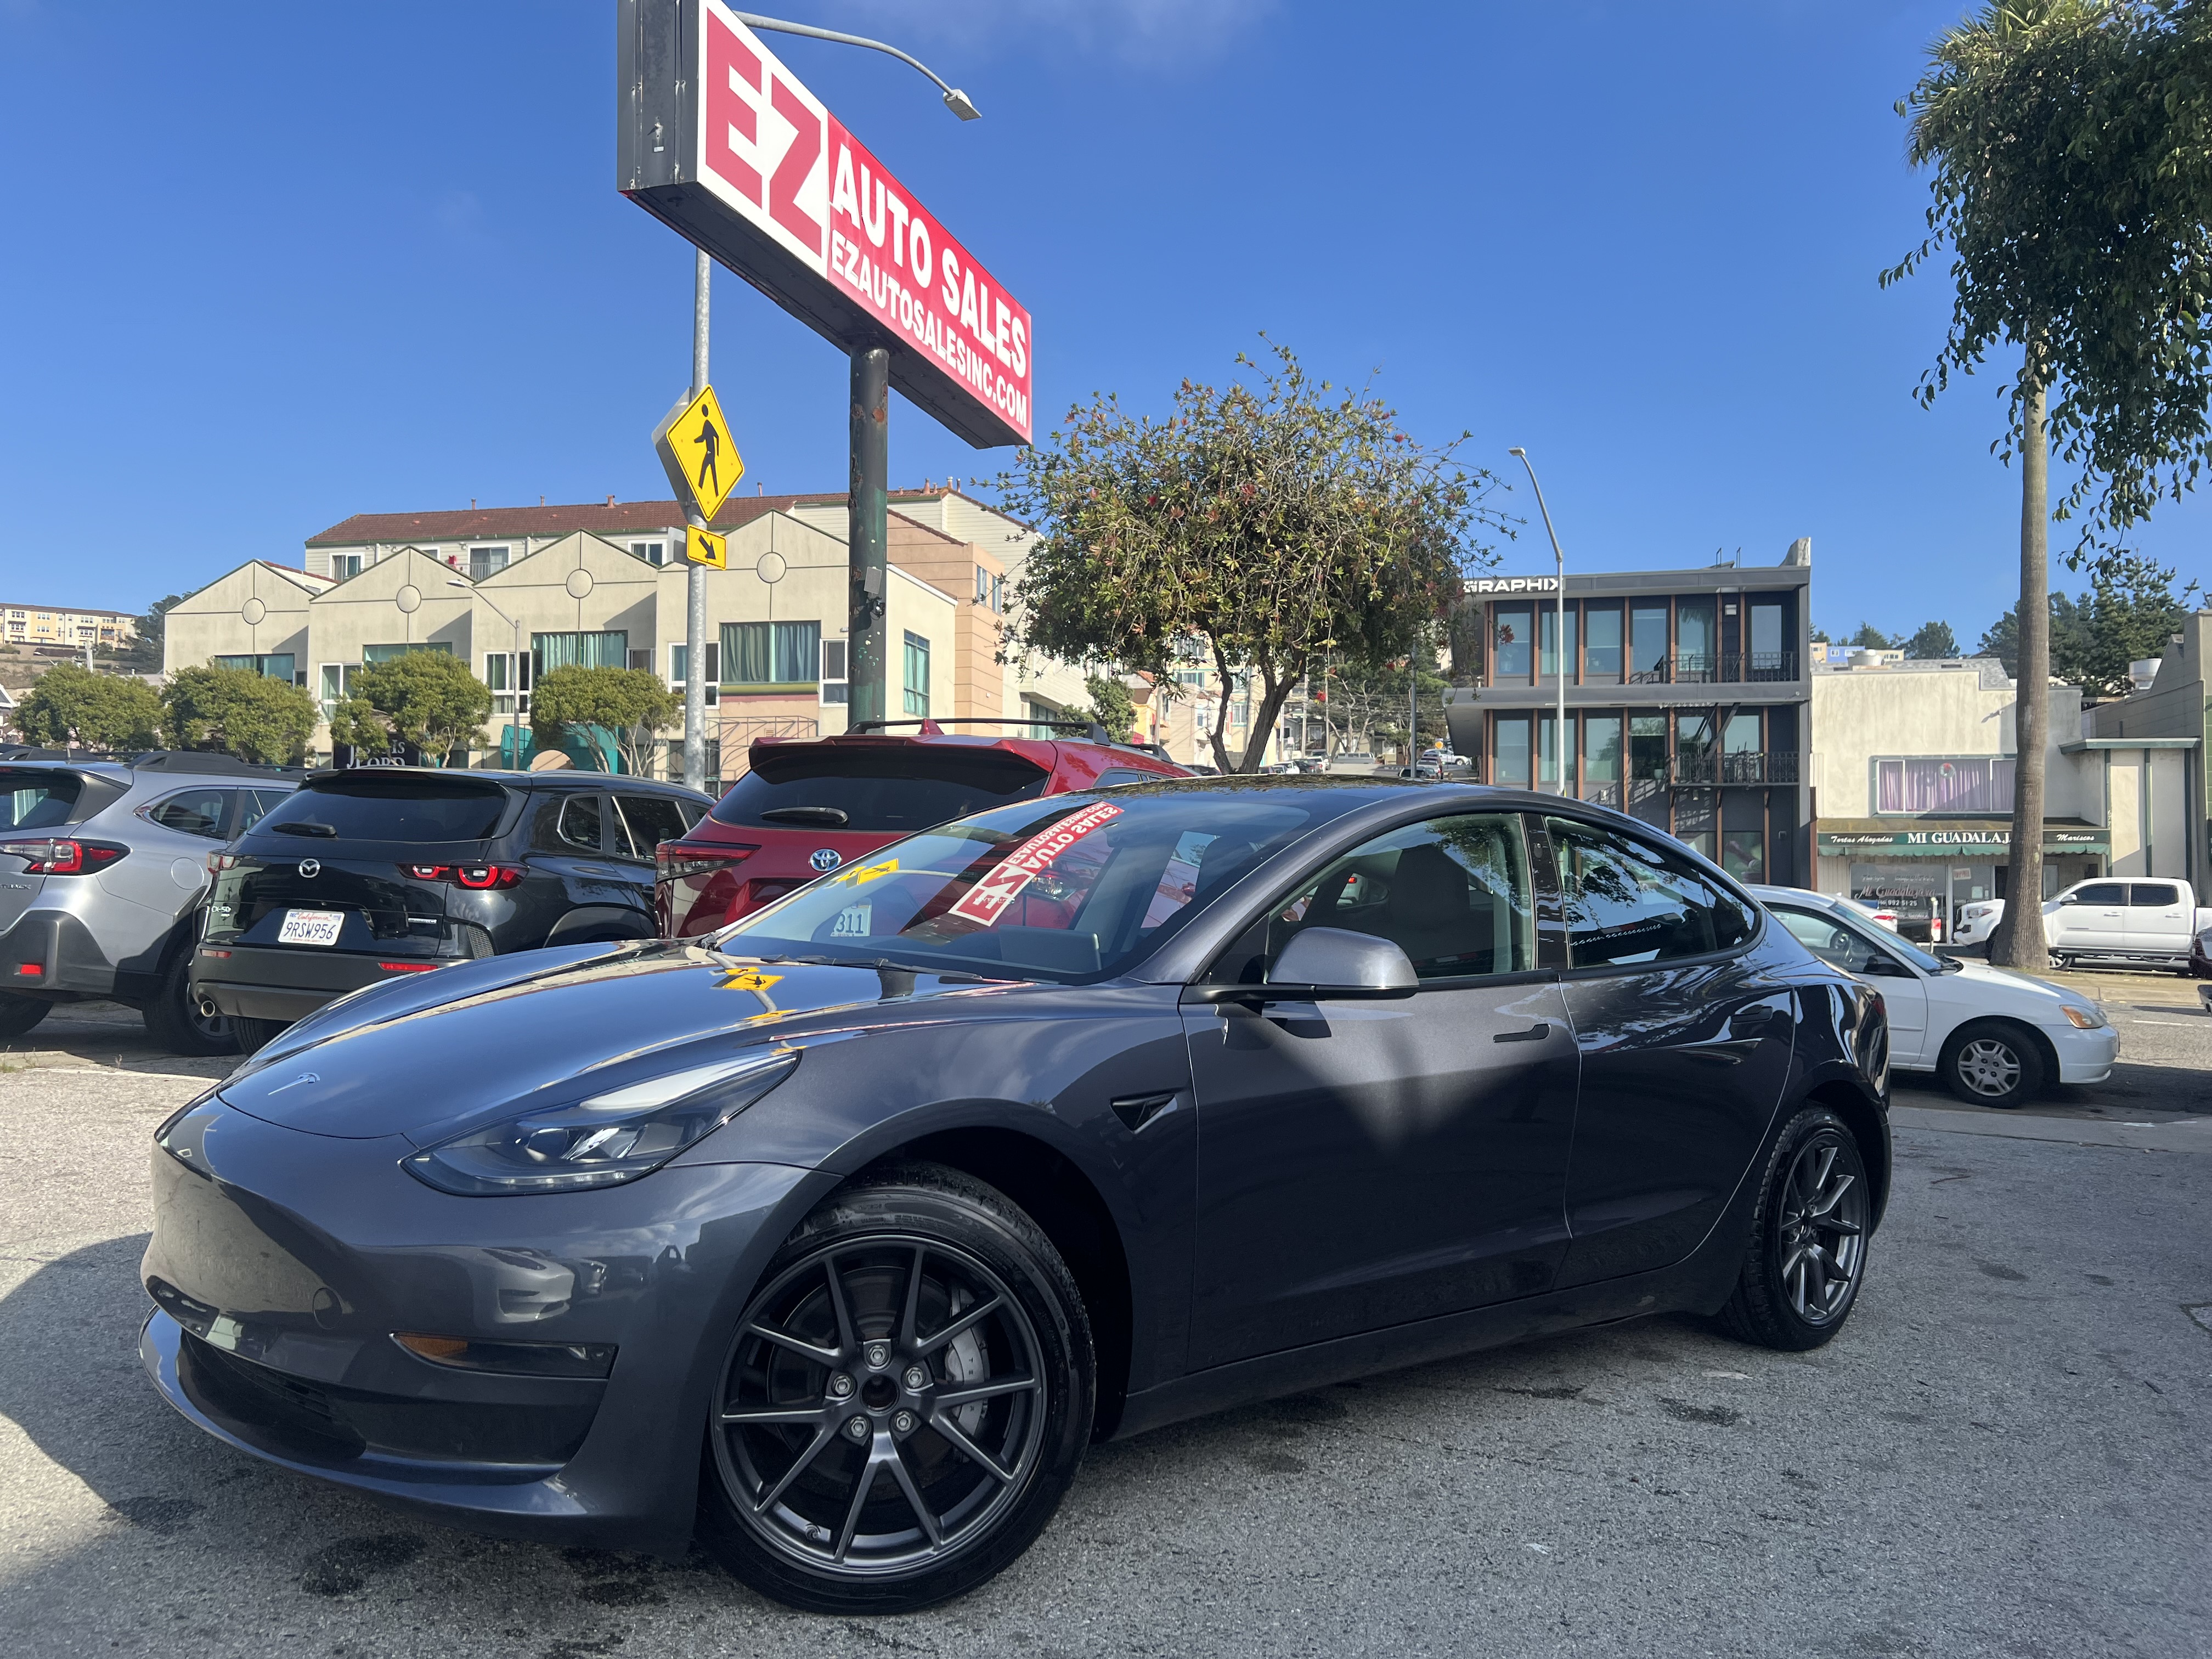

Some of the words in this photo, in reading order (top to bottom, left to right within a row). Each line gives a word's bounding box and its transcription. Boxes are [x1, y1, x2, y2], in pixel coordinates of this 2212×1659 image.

[706, 7, 822, 258] EZ
[830, 143, 932, 288] AUTO
[942, 248, 1026, 378] SALES
[831, 228, 1027, 428] EZAUTOSALESINC.COM
[1463, 578, 1564, 593] GRAPHIX
[1857, 835, 1893, 844] Ahogadas
[1908, 832, 1927, 844] MI
[1932, 832, 2012, 844] GUADALAJ
[284, 922, 336, 939] 9RSW956
